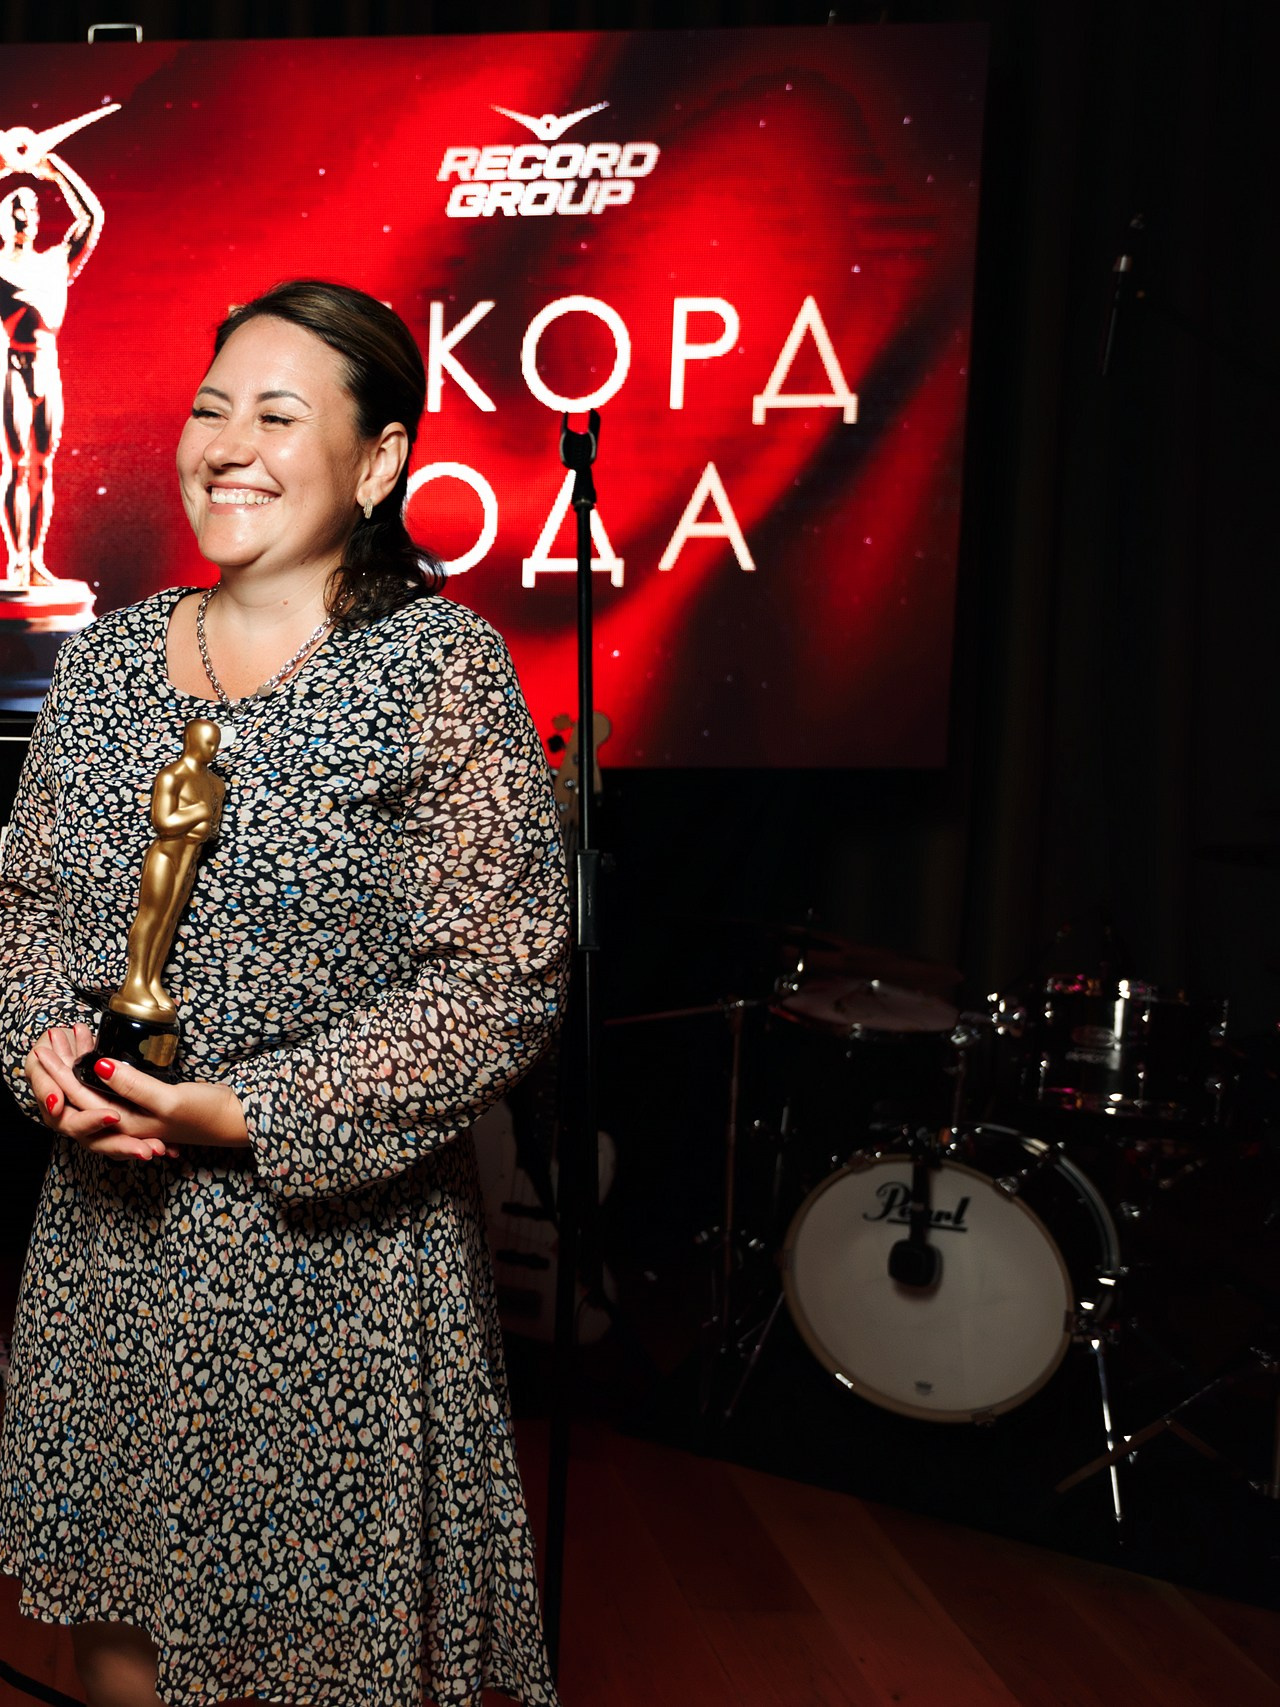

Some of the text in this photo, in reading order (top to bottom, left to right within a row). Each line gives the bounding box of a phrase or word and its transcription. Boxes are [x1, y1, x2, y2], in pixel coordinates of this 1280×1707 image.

[436, 142, 661, 182] RECORD
[445, 179, 635, 217] GROUP
[228, 295, 858, 425] КОРД
[405, 460, 756, 588] ОДА
[862, 1181, 971, 1227] Perl
